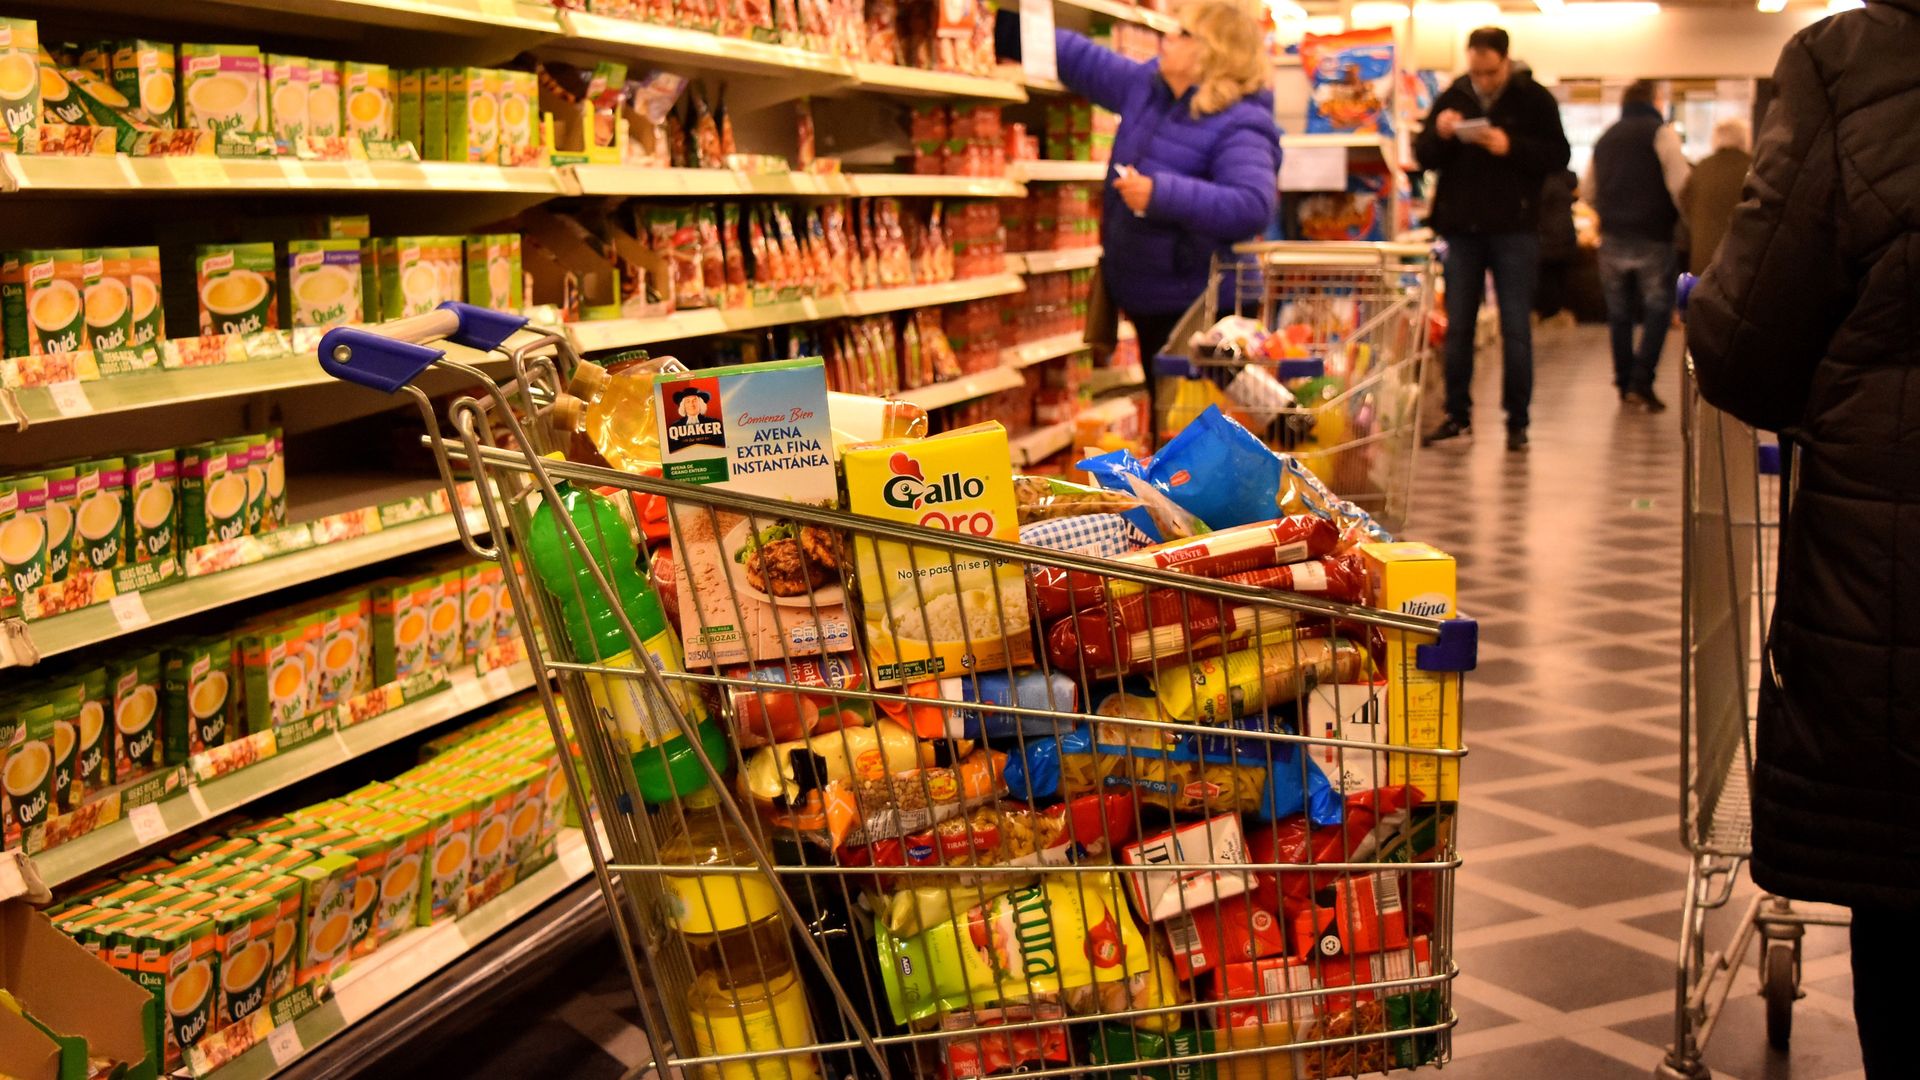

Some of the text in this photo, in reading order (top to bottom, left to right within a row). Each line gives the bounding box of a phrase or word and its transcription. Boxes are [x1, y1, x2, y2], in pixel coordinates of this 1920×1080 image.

[135, 323, 155, 346] uick
[737, 407, 814, 427] Comienza Bien
[668, 421, 722, 440] QUAKER
[753, 426, 801, 443] AVENA
[737, 438, 821, 459] EXTRA FINA
[733, 454, 829, 475] INSTANTÁNEA
[884, 473, 983, 510] Gallo
[92, 538, 118, 565] Quick
[149, 528, 170, 553] Quick
[1161, 549, 1203, 564] VICENTE
[14, 562, 43, 592] Quick
[897, 570, 913, 580] No
[957, 560, 967, 572] ni
[968, 560, 981, 570] se
[982, 557, 1010, 570] pga
[1402, 601, 1447, 617] Vitina
[699, 633, 737, 643] RBOZAR
[828, 658, 843, 689] RCOR
[203, 715, 225, 742] Quick
[130, 731, 154, 758] Quick
[20, 790, 47, 823] Quick
[902, 957, 912, 975] AGD
[139, 973, 162, 985] Quick
[235, 987, 262, 1018] Quick
[181, 1010, 206, 1043] Quick
